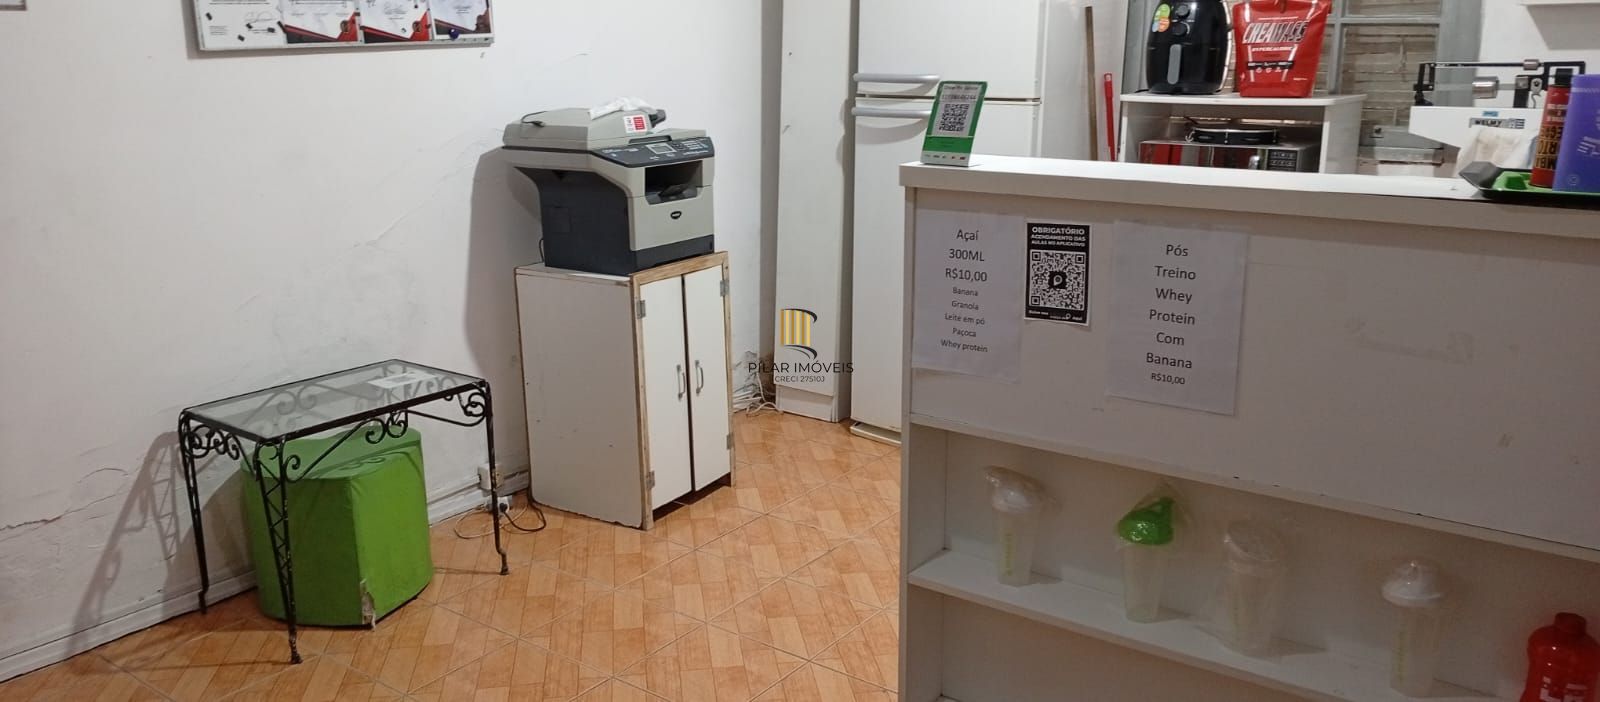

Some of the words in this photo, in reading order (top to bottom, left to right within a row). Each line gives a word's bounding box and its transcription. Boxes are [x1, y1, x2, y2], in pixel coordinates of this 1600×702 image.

[1242, 20, 1308, 44] CREAMASS
[956, 229, 979, 242] Açaí
[1032, 226, 1085, 235] OBRIGATÓRIO
[949, 248, 985, 262] 300ML
[1166, 244, 1189, 257] Pós
[945, 268, 987, 282] R$10,00
[1154, 266, 1196, 280] Treino
[952, 287, 978, 296] Banana
[1156, 288, 1192, 304] Whey
[951, 301, 979, 310] Granola
[944, 313, 962, 322] Leite
[976, 317, 985, 325] pó
[1149, 309, 1195, 325] Protein
[952, 328, 976, 337] Paçoca
[1156, 332, 1185, 346] Com
[940, 339, 961, 349] Whey
[962, 342, 988, 352] protein
[1146, 352, 1192, 369] Banana
[1151, 372, 1185, 385] R$10,00
